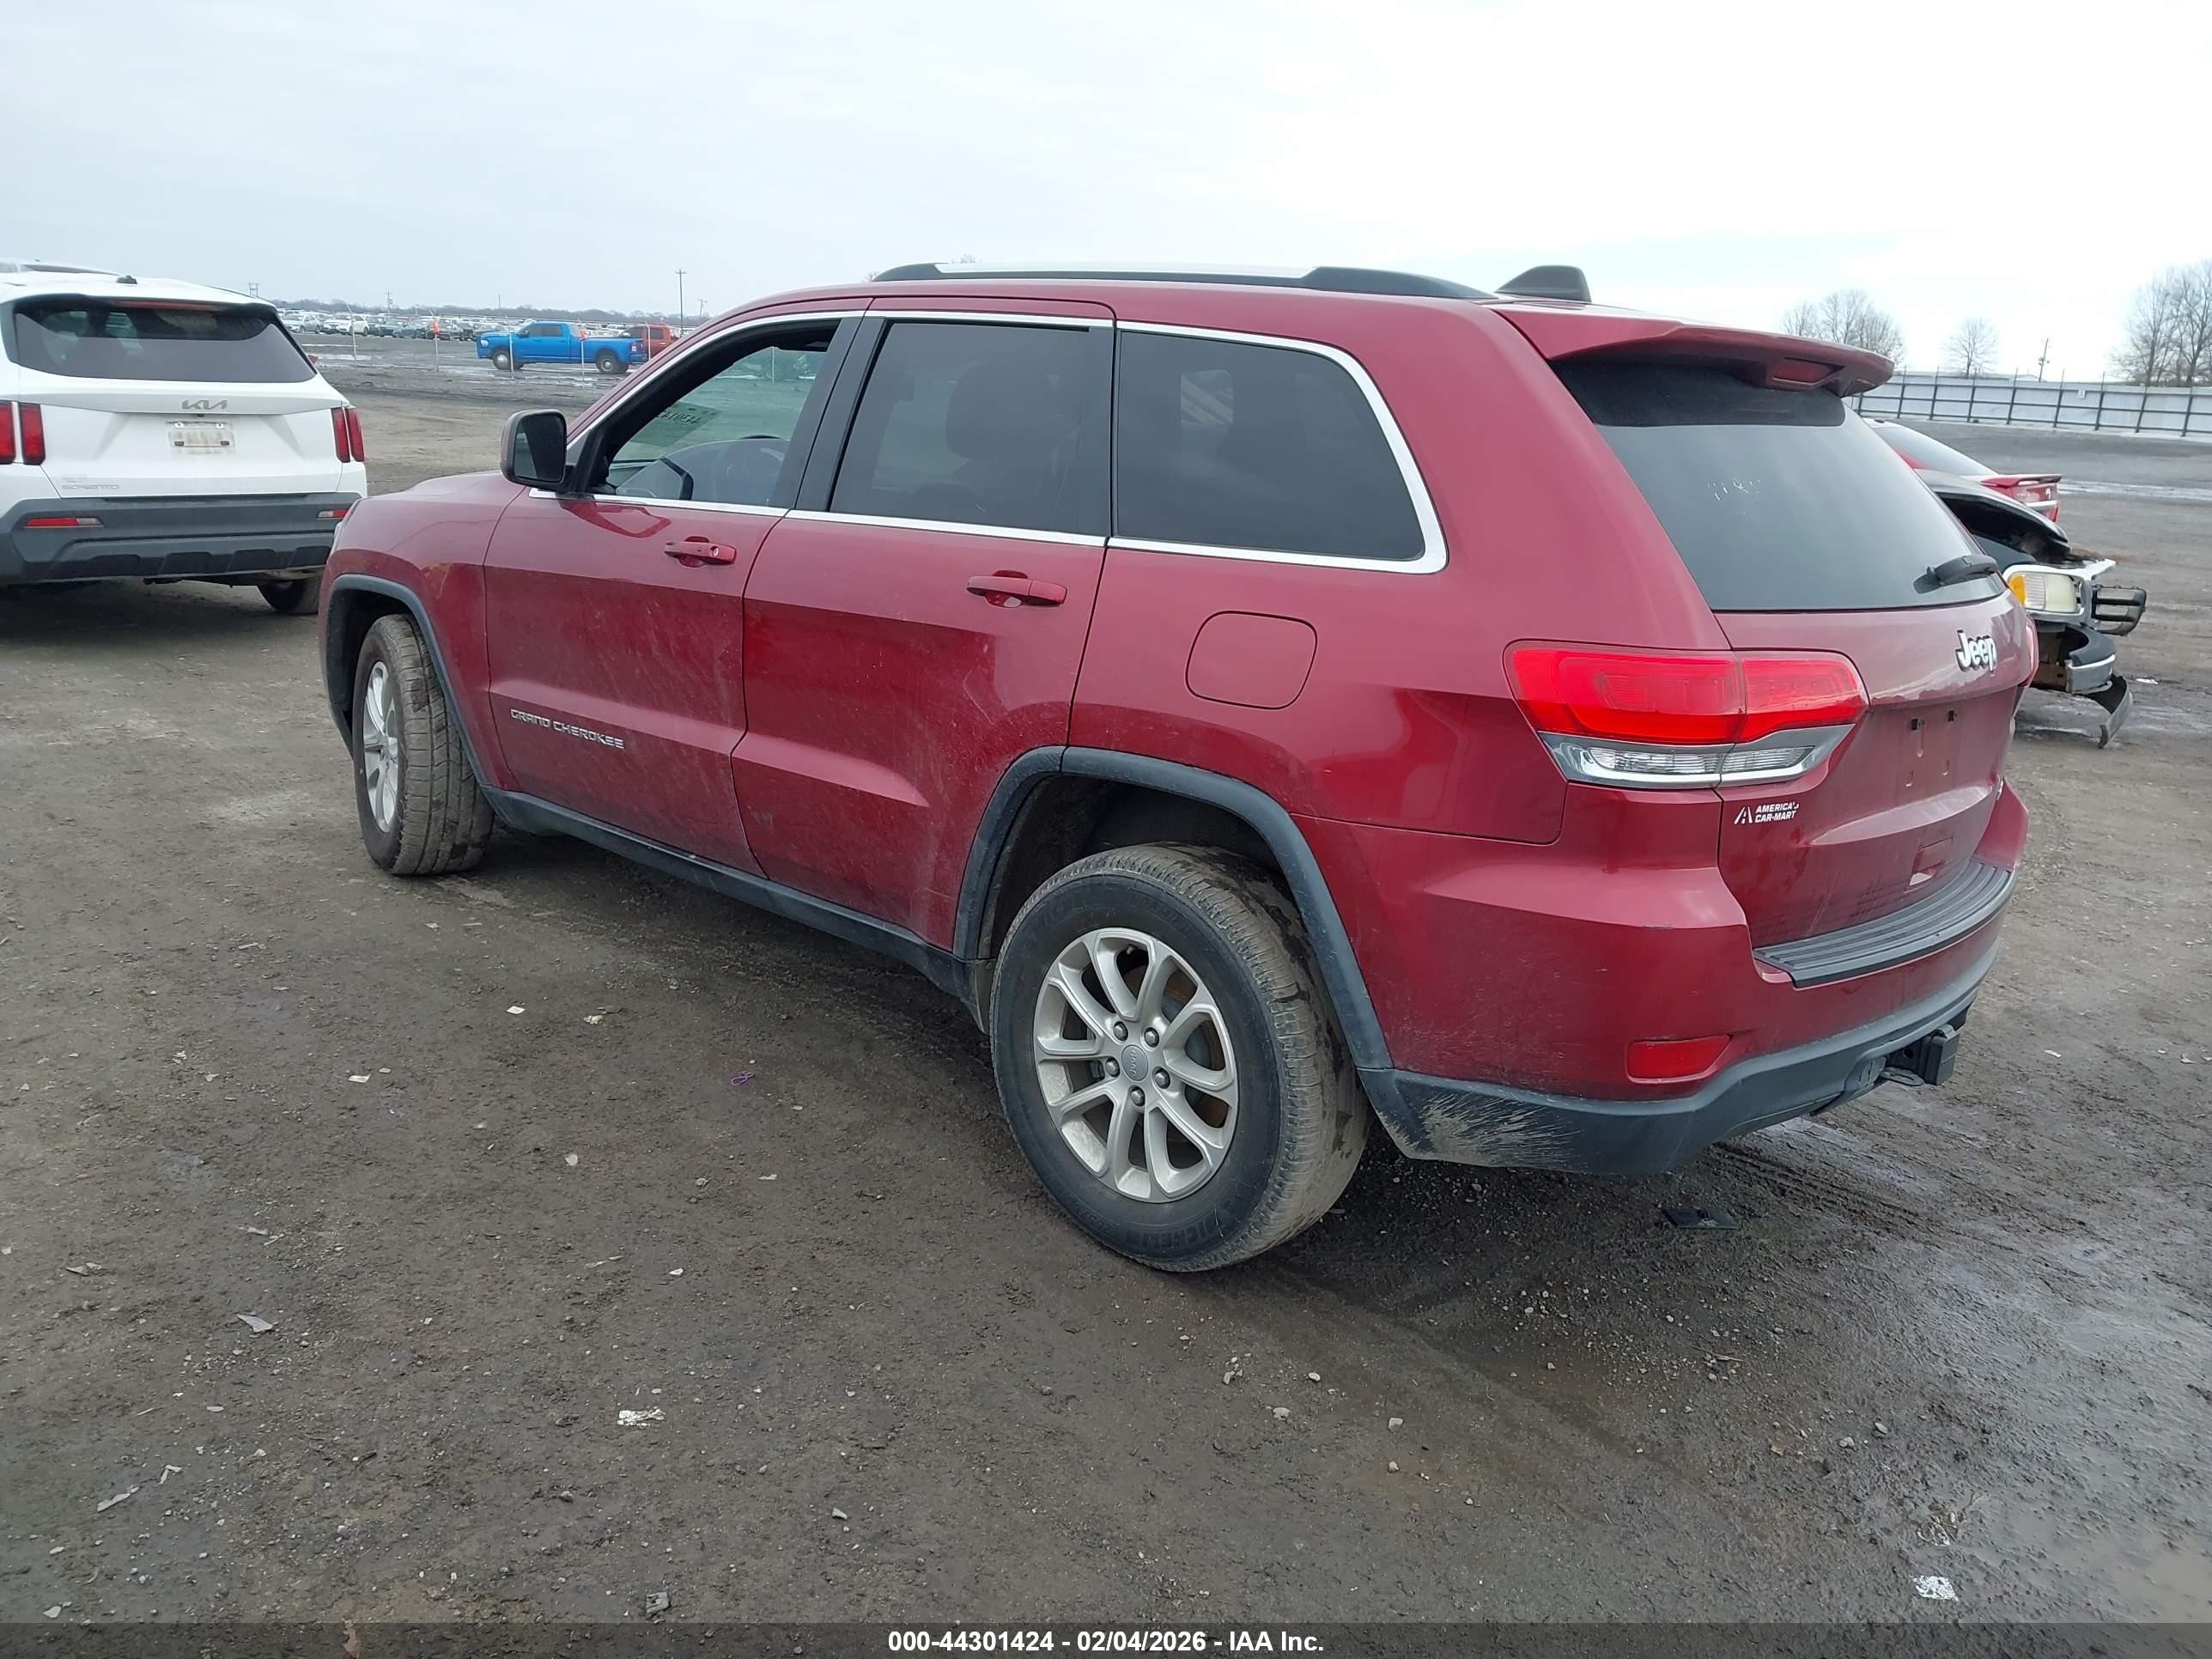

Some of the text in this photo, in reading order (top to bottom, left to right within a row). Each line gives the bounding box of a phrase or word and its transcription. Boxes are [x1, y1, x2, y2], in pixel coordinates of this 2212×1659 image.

[1955, 629, 1997, 673] Jeep
[510, 708, 625, 750] GRAND CHEROKEE
[1754, 810, 1797, 823] CAR-MART
